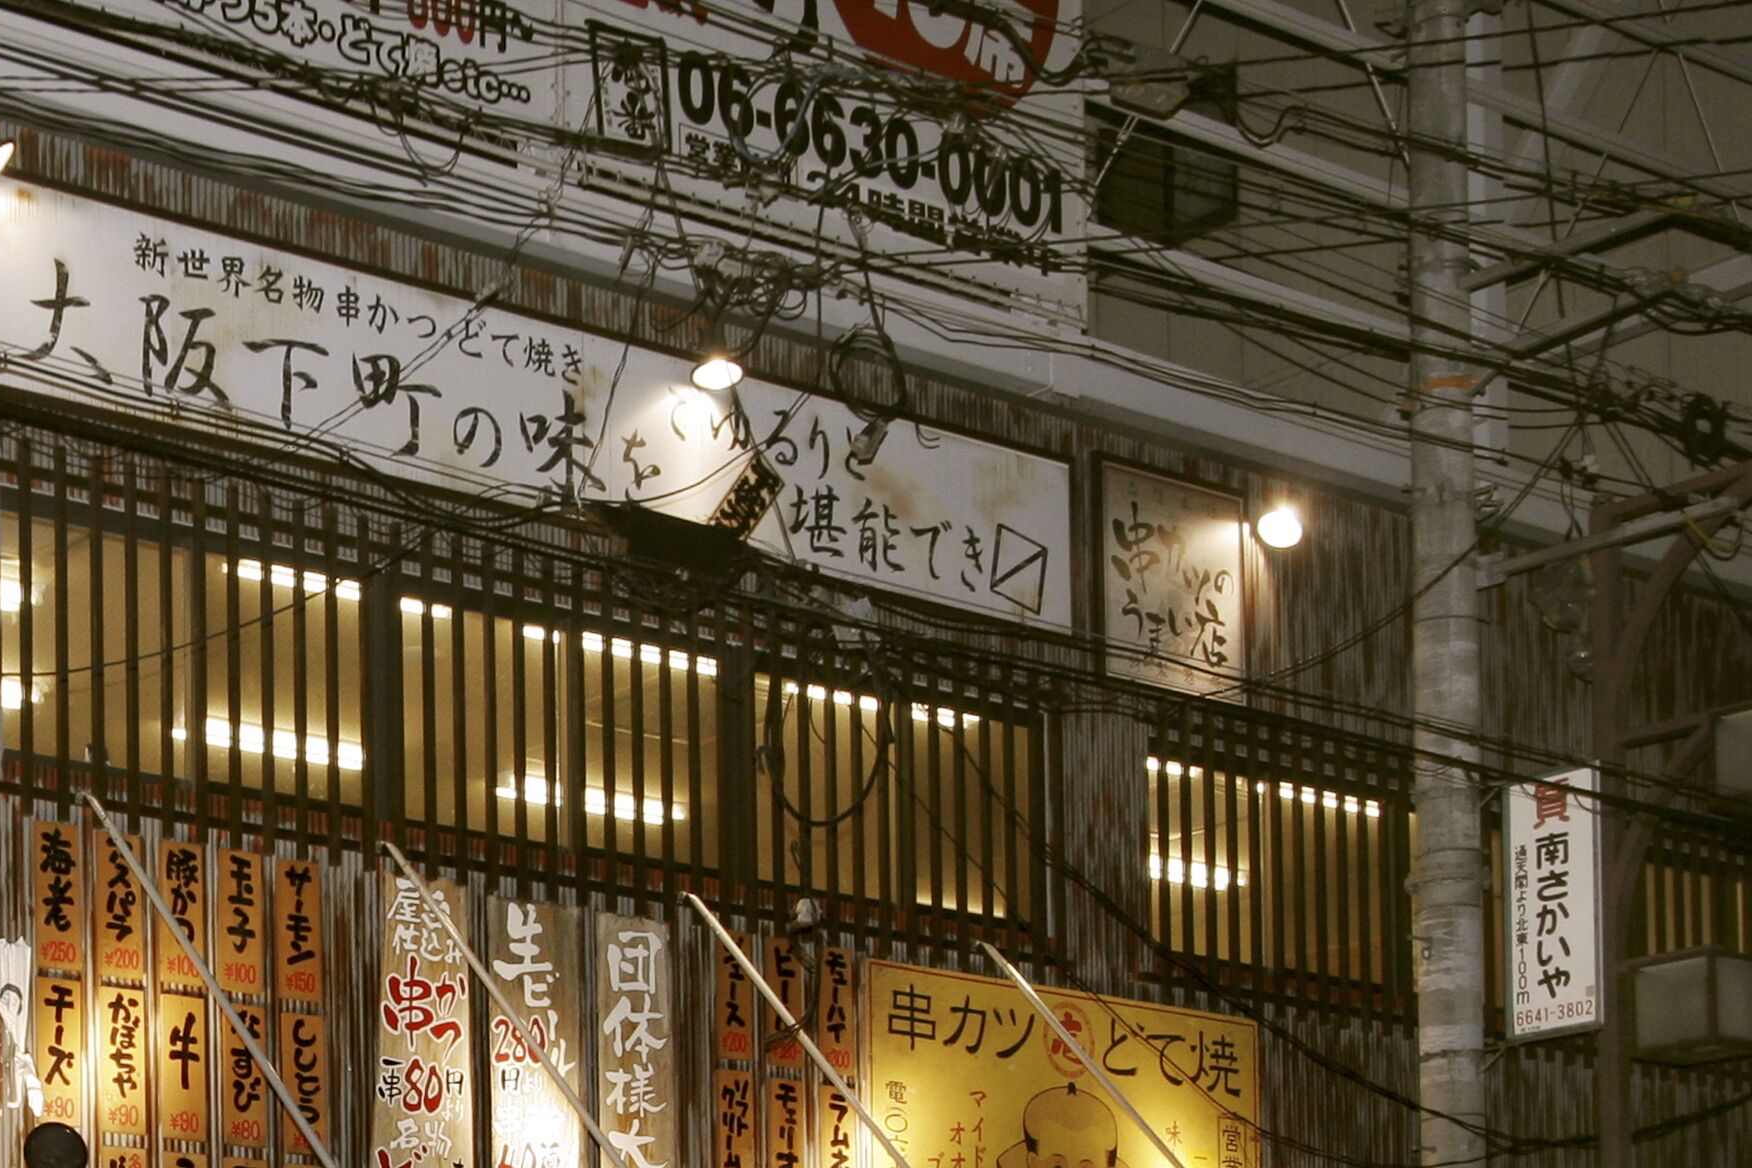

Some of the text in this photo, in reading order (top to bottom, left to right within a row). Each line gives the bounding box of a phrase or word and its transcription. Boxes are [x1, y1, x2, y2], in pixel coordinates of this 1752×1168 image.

[40, 828, 76, 963] 海老 ¥250
[224, 855, 257, 984] 玉子 ¥100
[284, 866, 316, 993] サーモン ¥150
[1535, 831, 1571, 999] 南さかいや
[104, 949, 140, 969] ¥200
[382, 953, 469, 1054] 串かつ
[1516, 1000, 1593, 1027] 6641-3802
[43, 985, 76, 1120] チーズ ¥90
[108, 992, 139, 1127] かぼちゃ ¥90
[170, 1011, 201, 1133] 牛 ¥90
[887, 982, 1036, 1060] 串カツ
[1102, 1017, 1242, 1097] どて焼
[231, 1122, 261, 1140] ¥80
